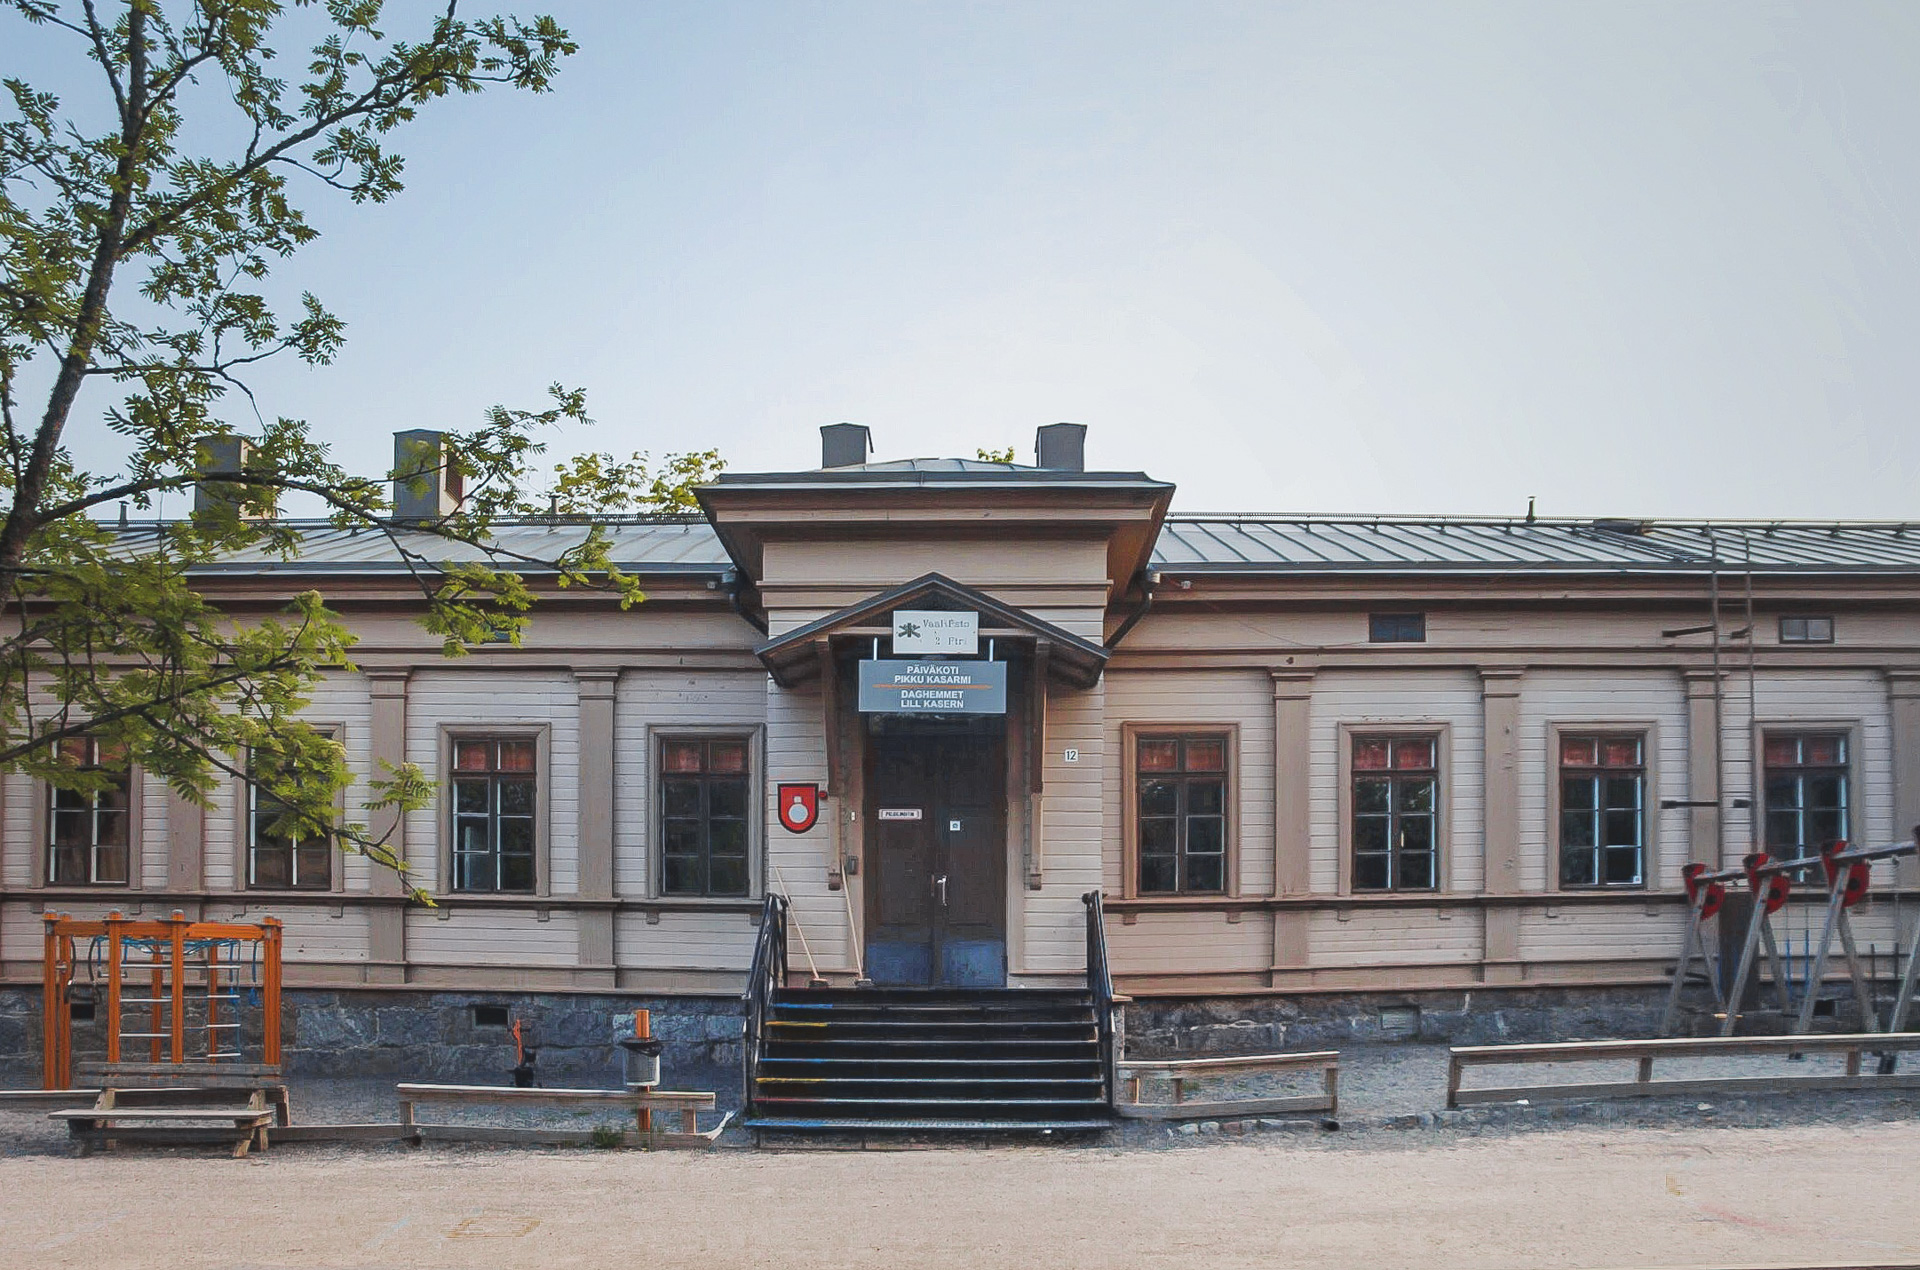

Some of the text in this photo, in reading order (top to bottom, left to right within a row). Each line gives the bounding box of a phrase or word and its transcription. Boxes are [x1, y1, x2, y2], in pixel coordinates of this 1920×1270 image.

[906, 664, 959, 675] PÄIVÄKOTI
[894, 675, 972, 684] PIKKU KASARMI
[901, 690, 964, 699] DAGHEMMET
[901, 700, 964, 709] LILL KASERN
[1066, 750, 1077, 760] 12
